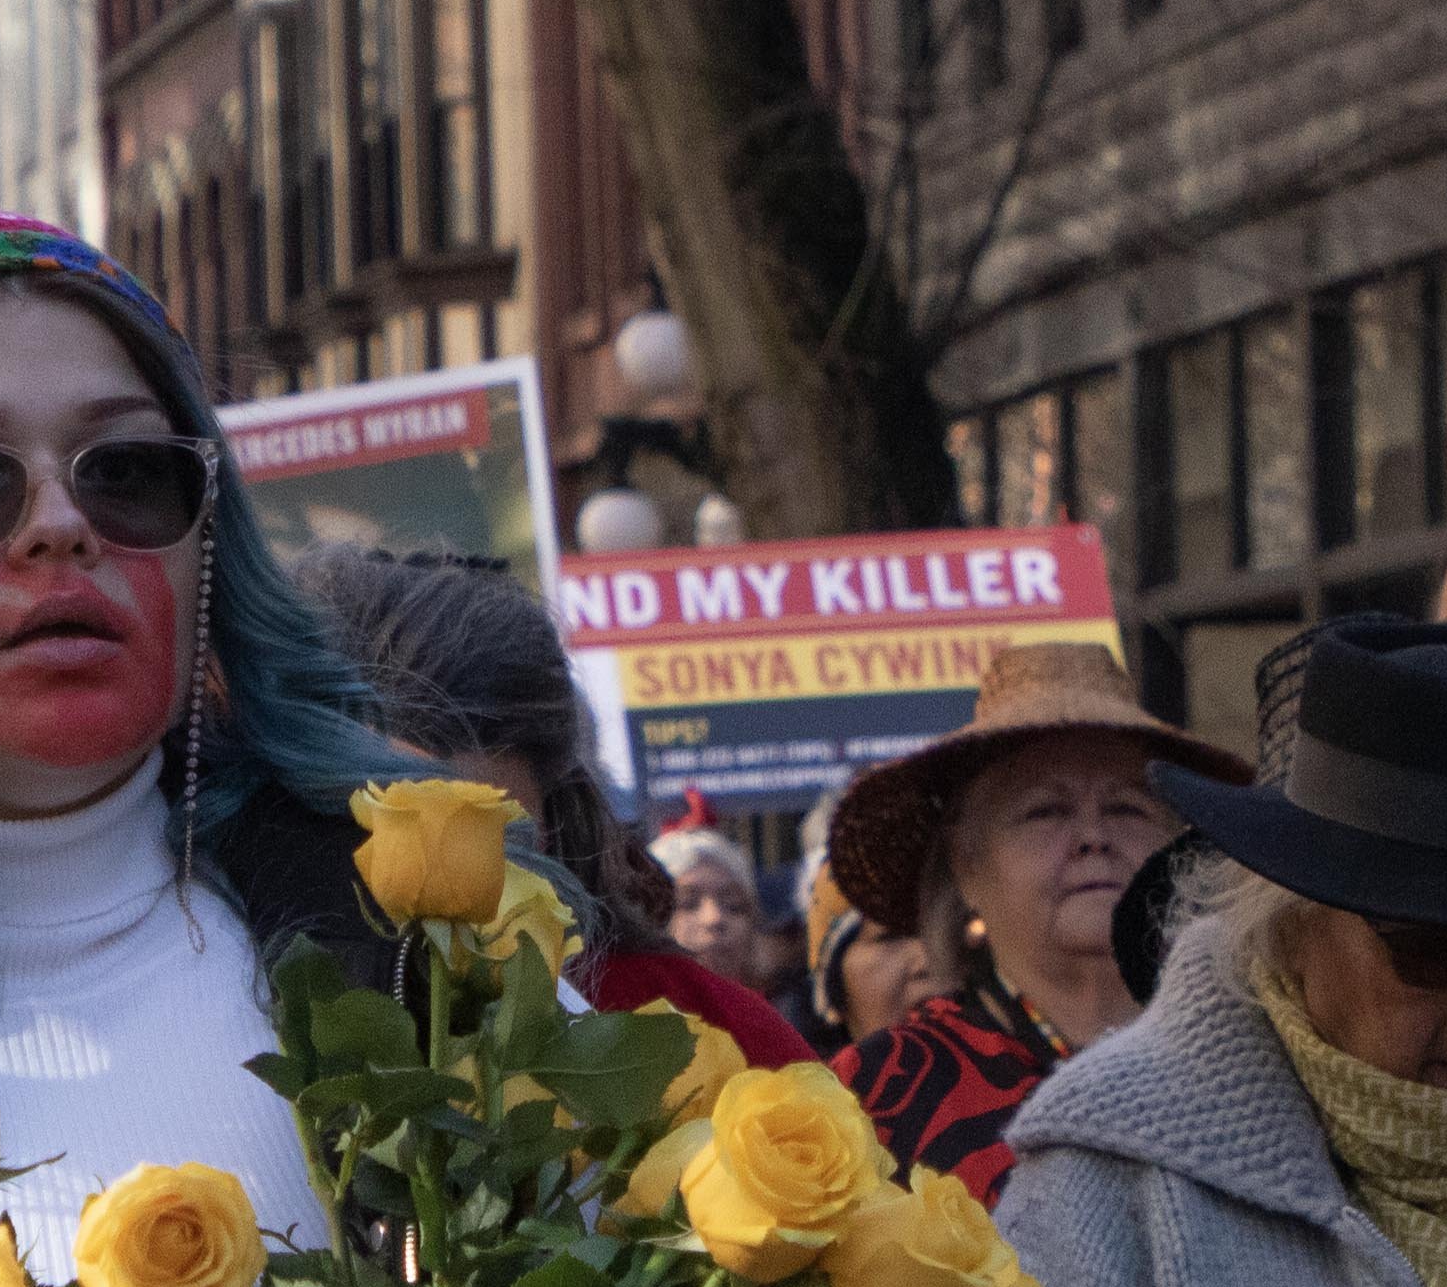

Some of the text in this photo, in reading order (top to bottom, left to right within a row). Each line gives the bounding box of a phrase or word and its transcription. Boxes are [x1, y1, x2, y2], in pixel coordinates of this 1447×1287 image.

[561, 547, 1062, 630] ND MY KILLER
[633, 648, 799, 701] SONYA
